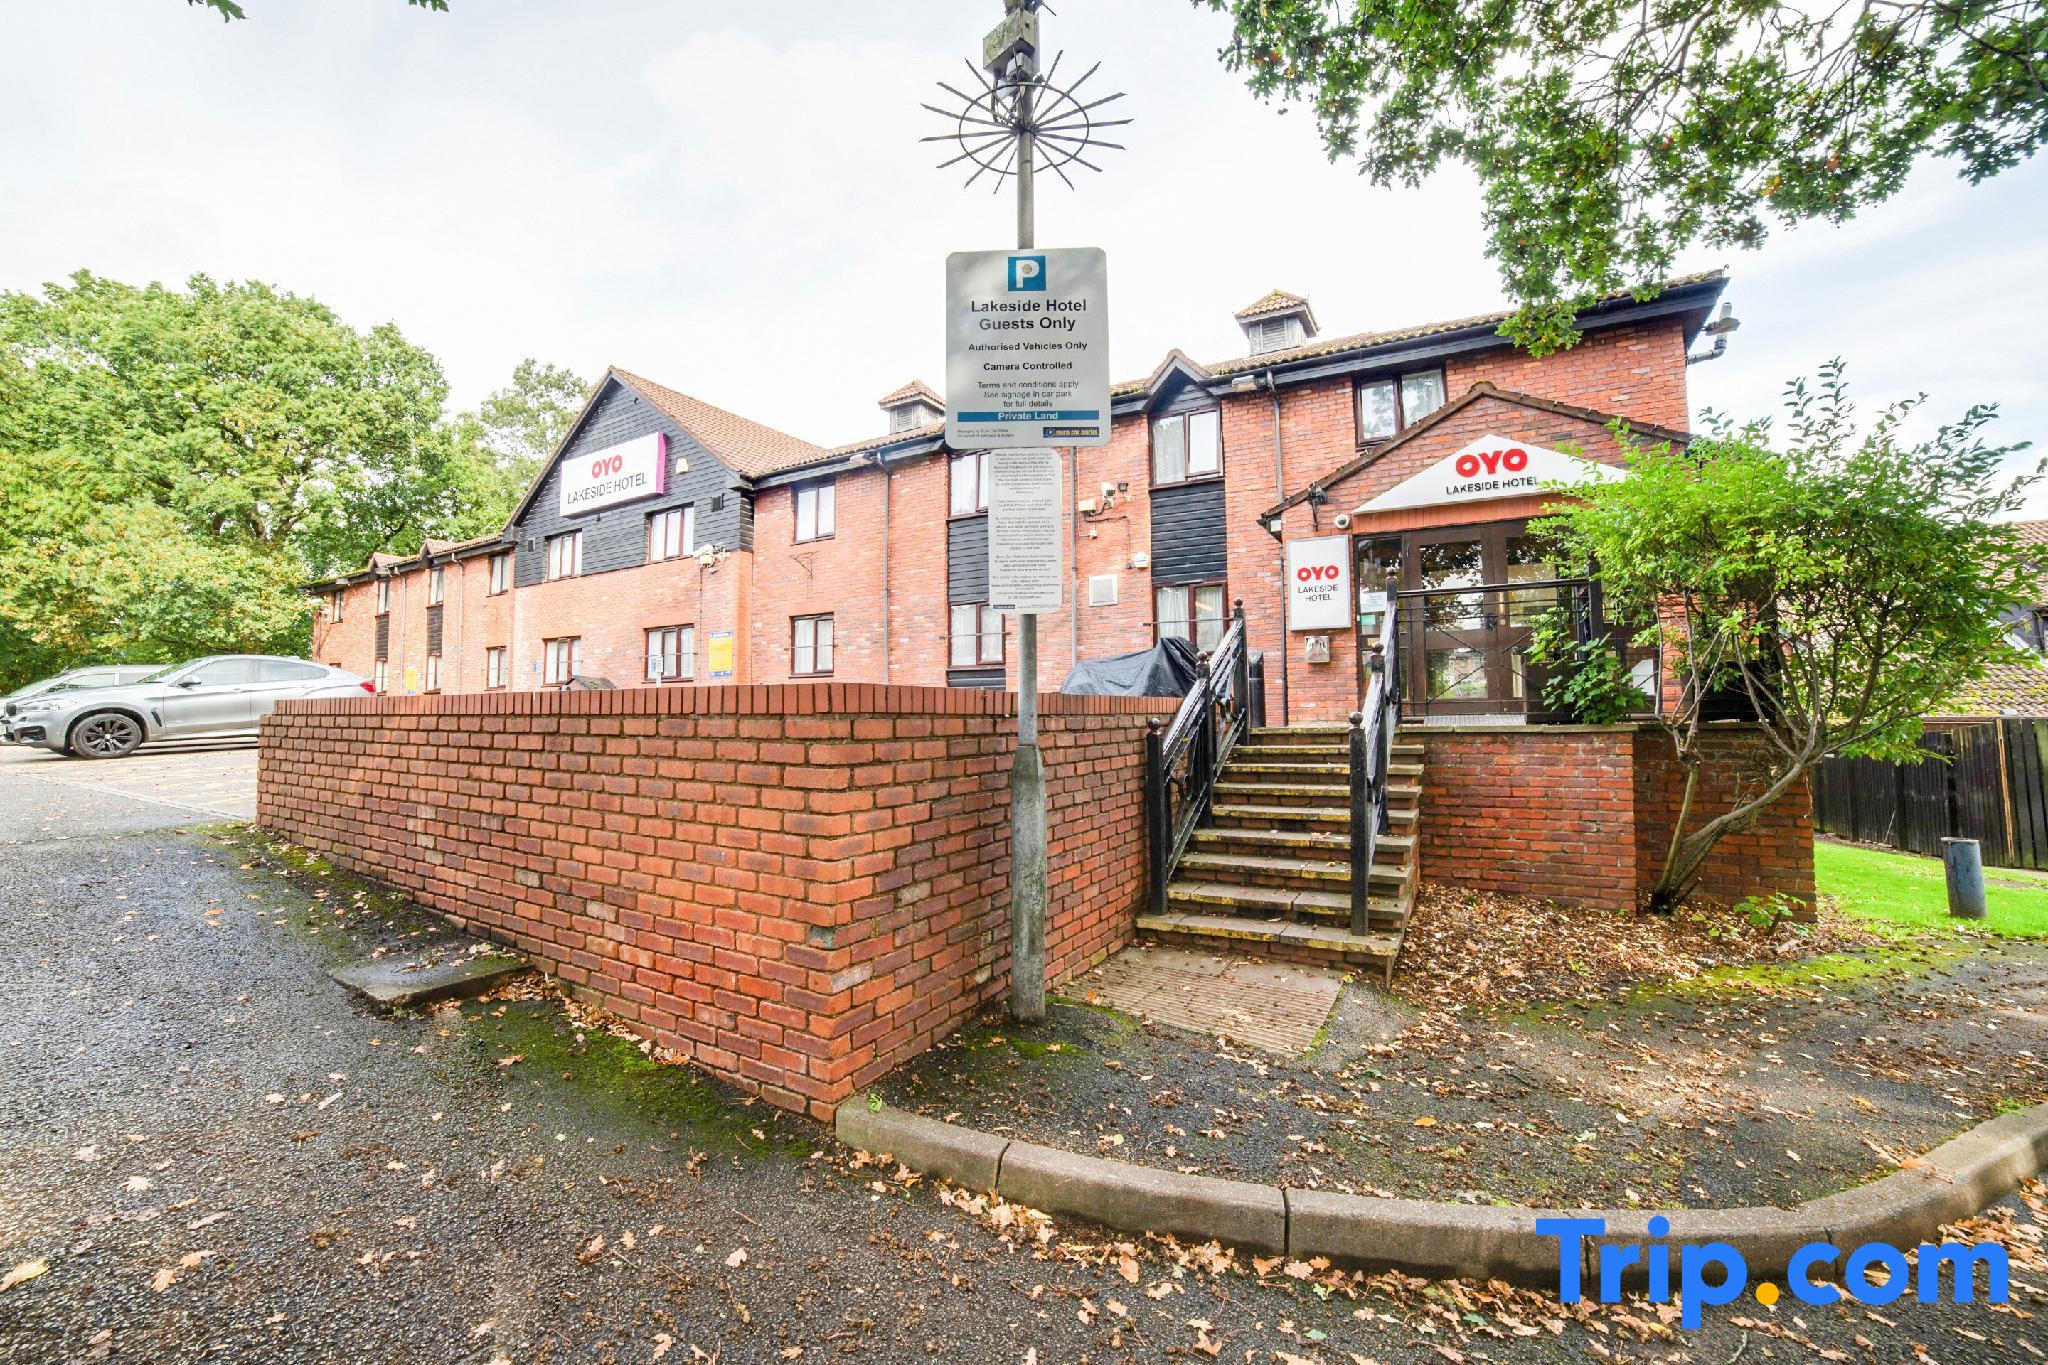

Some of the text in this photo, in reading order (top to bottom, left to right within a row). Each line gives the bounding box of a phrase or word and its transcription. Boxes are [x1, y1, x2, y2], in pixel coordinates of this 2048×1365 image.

[1016, 260, 1040, 288] P
[971, 299, 1087, 312] Lakeside Hotel
[979, 317, 1076, 331] Guests Only
[968, 341, 1088, 351] Authorised Vehicles Only
[983, 361, 1073, 371] Camera Controlled
[977, 380, 1079, 390] Terms and conditions apply
[984, 391, 999, 399] See
[1001, 391, 1031, 400] signage
[1032, 390, 1040, 398] in
[1055, 390, 1073, 399] park
[1003, 400, 1053, 408] for full details
[998, 411, 1059, 420] Private Land
[592, 454, 622, 478] OYO
[1455, 448, 1528, 477] OYO
[567, 472, 648, 505] LAKESIDE HOTEL
[1446, 476, 1539, 495] LAKESIDE HOTEL
[1297, 565, 1340, 582] OYO
[1298, 584, 1339, 594] LAKESIDE
[1306, 594, 1333, 602] HOTEL
